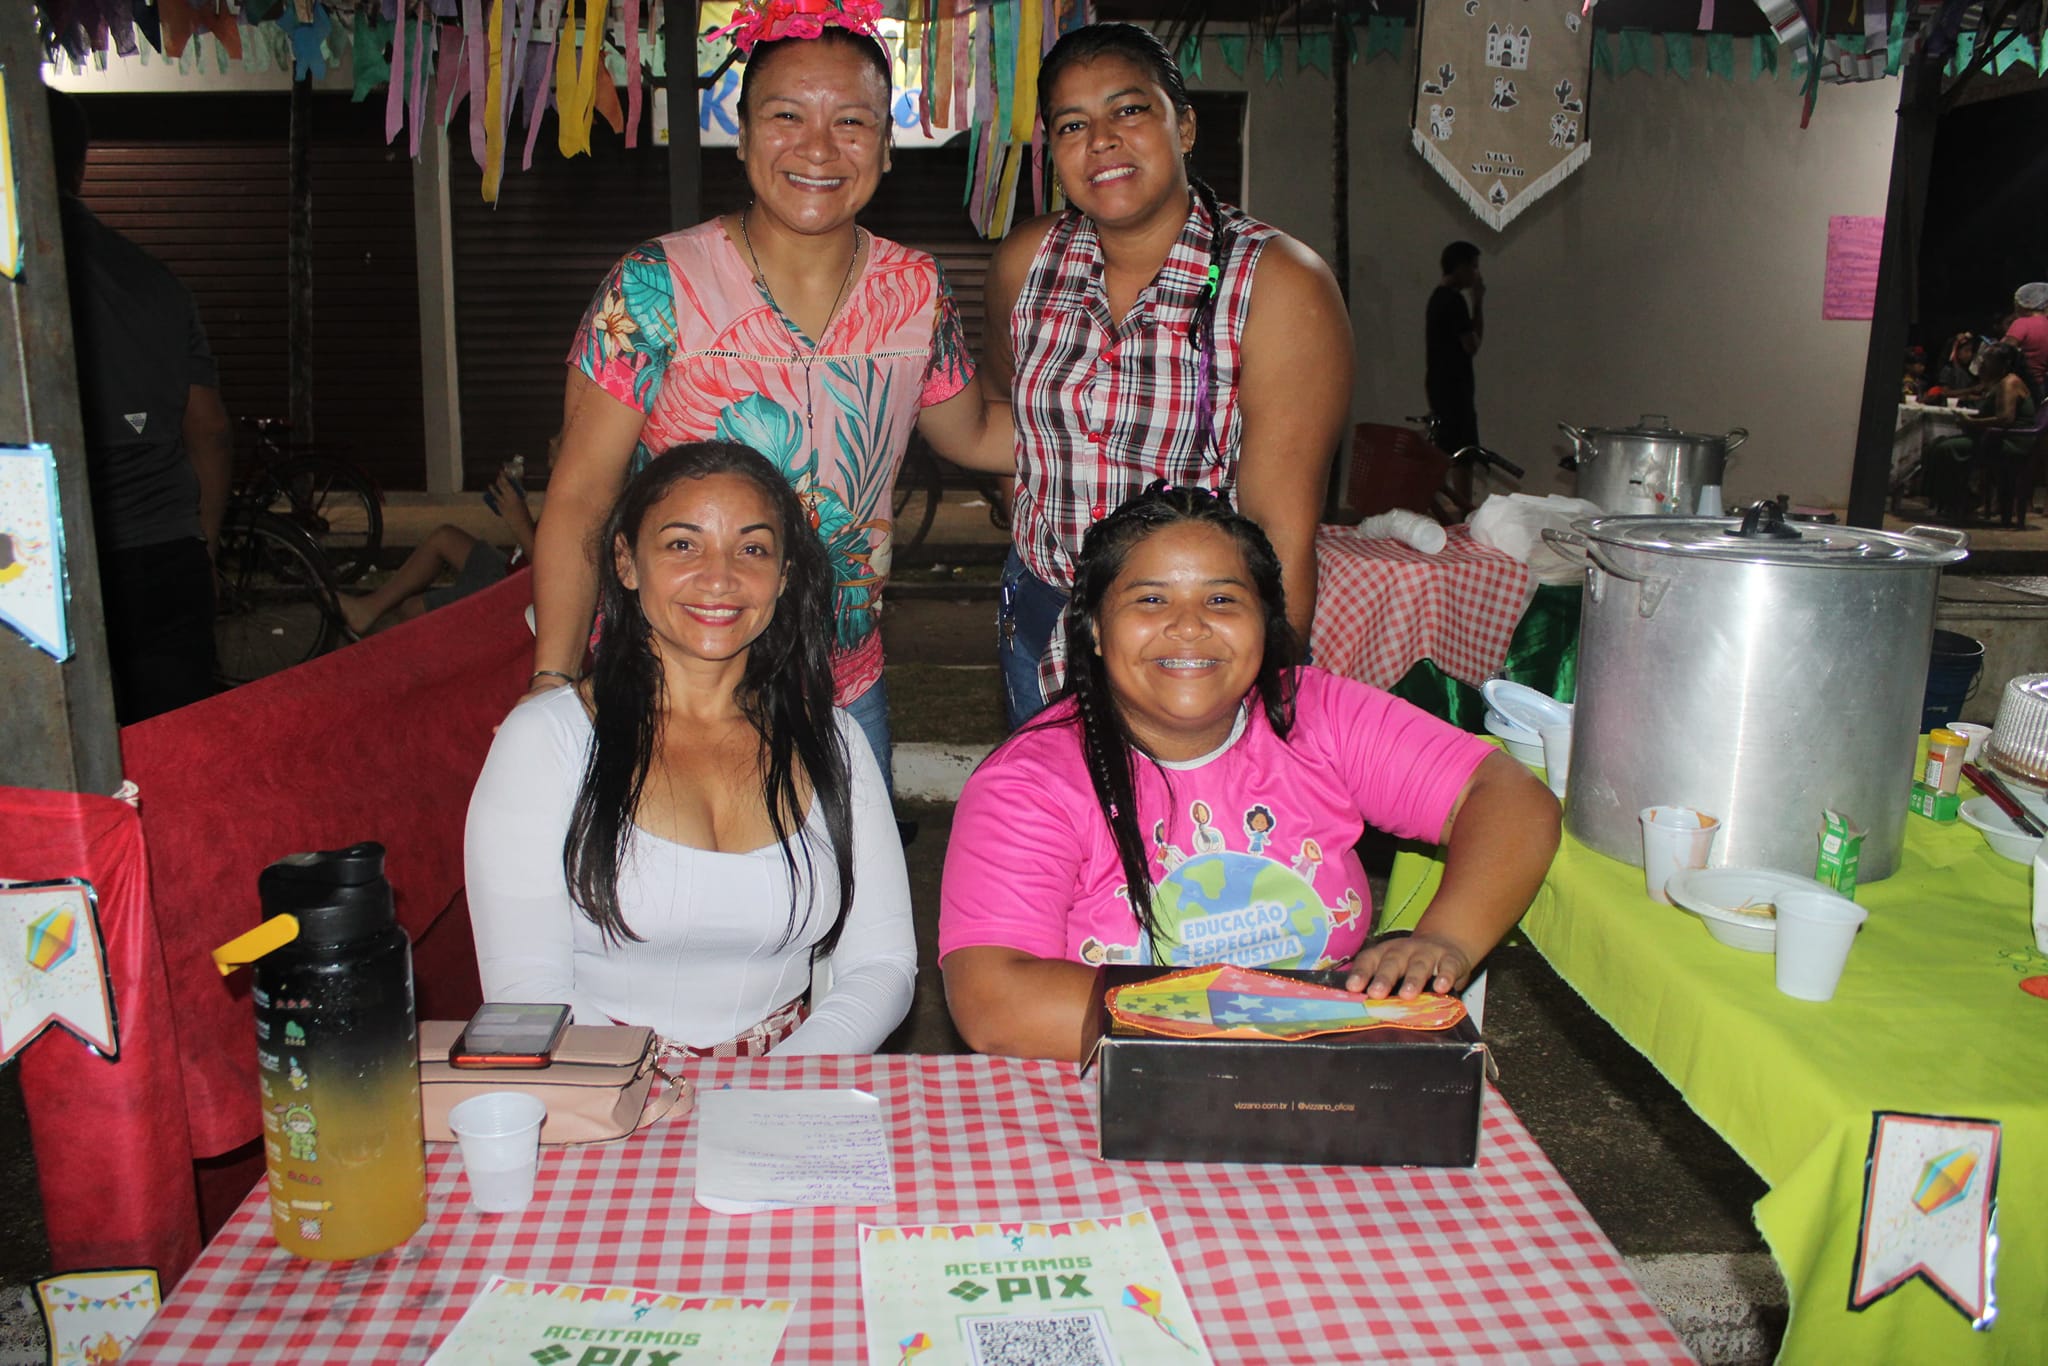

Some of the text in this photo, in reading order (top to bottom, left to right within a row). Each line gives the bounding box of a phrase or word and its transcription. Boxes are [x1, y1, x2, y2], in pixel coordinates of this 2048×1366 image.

[1183, 905, 1284, 940] EDUCAÇÃO
[1193, 926, 1281, 957] ESPECIAL
[1234, 1101, 1288, 1110] vizzano.com.br
[945, 1256, 1093, 1276] ACEITAMOS
[996, 1273, 1093, 1303] PIX
[542, 1325, 702, 1347] ACEITAMOS
[575, 1345, 683, 1366] PIX
